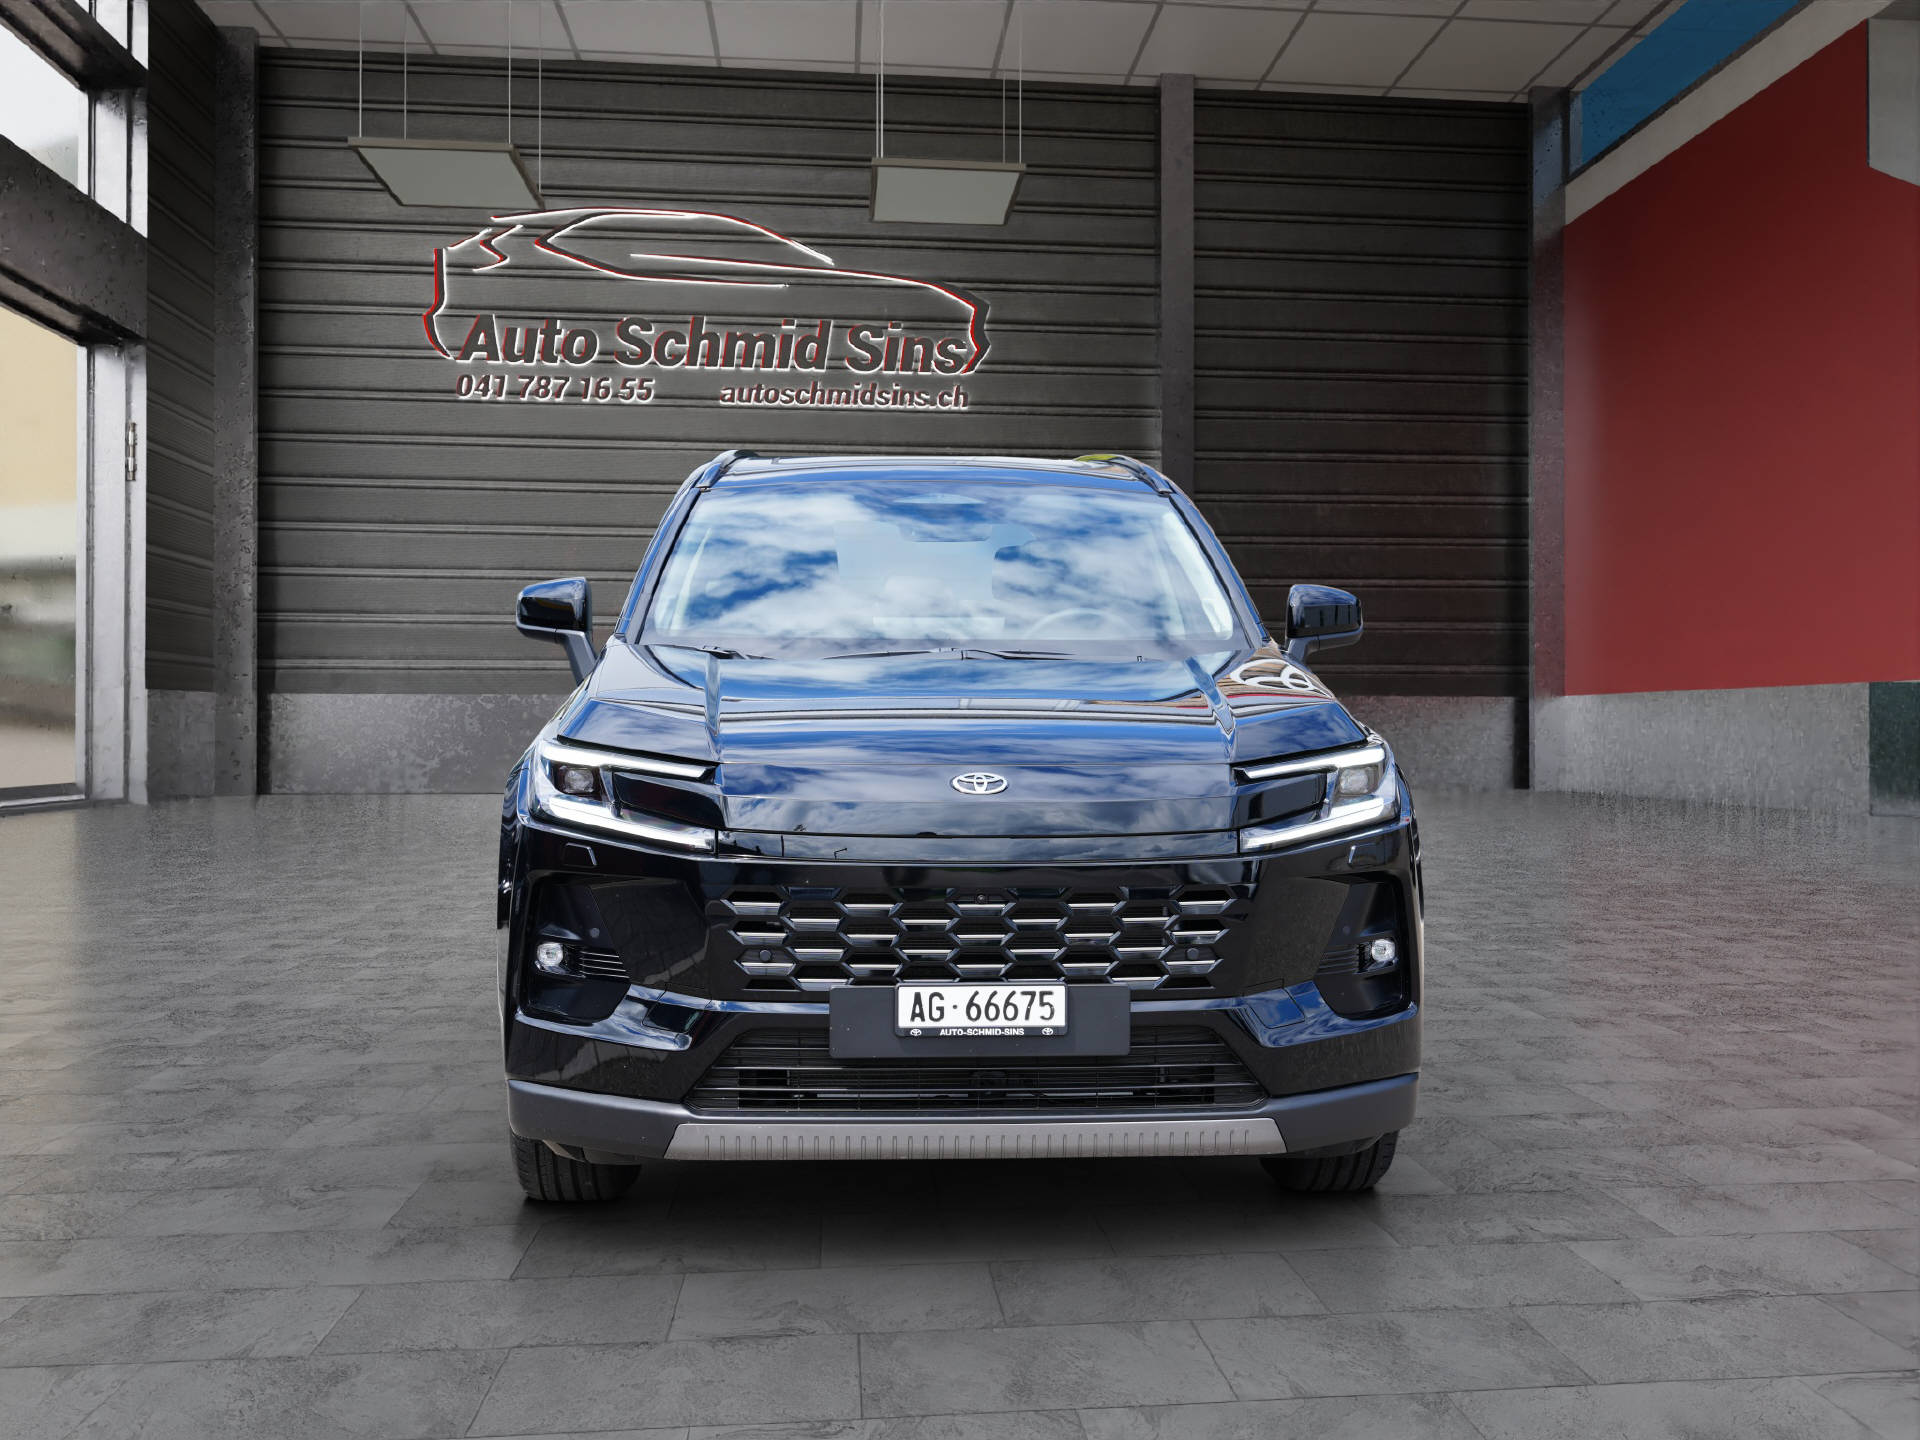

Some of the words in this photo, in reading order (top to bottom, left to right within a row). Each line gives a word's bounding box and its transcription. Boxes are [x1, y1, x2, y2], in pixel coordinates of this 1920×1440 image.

[455, 313, 600, 367] Auto
[614, 316, 834, 371] Schmid
[845, 321, 968, 375] Sins
[455, 373, 508, 399] 041
[517, 374, 570, 400] 787
[580, 376, 613, 402] 16
[618, 377, 656, 403] 55
[719, 380, 969, 410] autoschmidsins.ch
[939, 1027, 1025, 1037] AUTO-SCHMID-SINS
